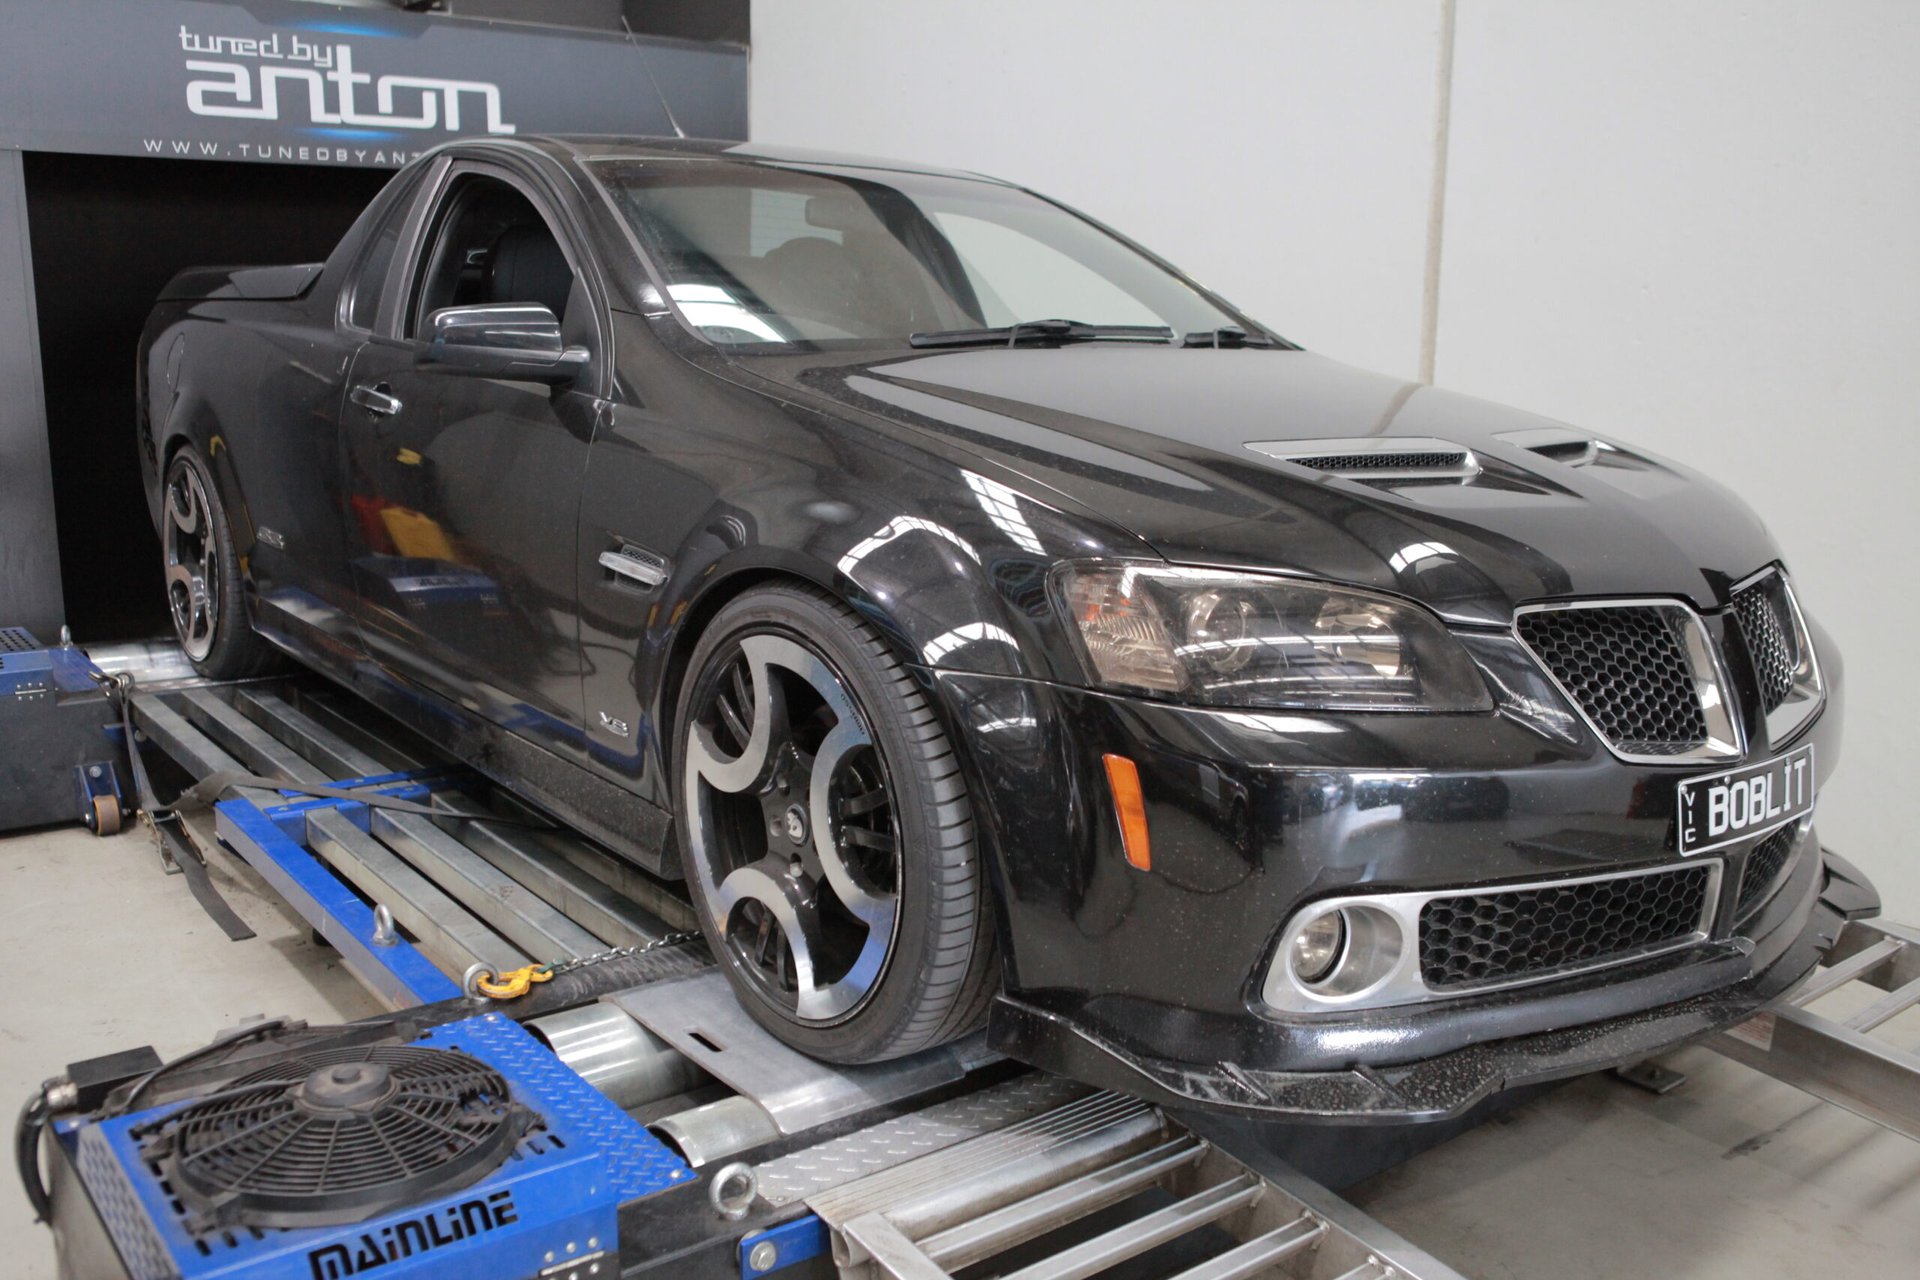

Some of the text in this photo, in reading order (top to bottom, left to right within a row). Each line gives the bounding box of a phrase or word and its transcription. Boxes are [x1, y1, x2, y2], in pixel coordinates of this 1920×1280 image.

[179, 25, 333, 68] tuned by
[186, 44, 516, 134] anton
[1684, 791, 1697, 843] VIC
[1708, 758, 1806, 837] BOBLIT
